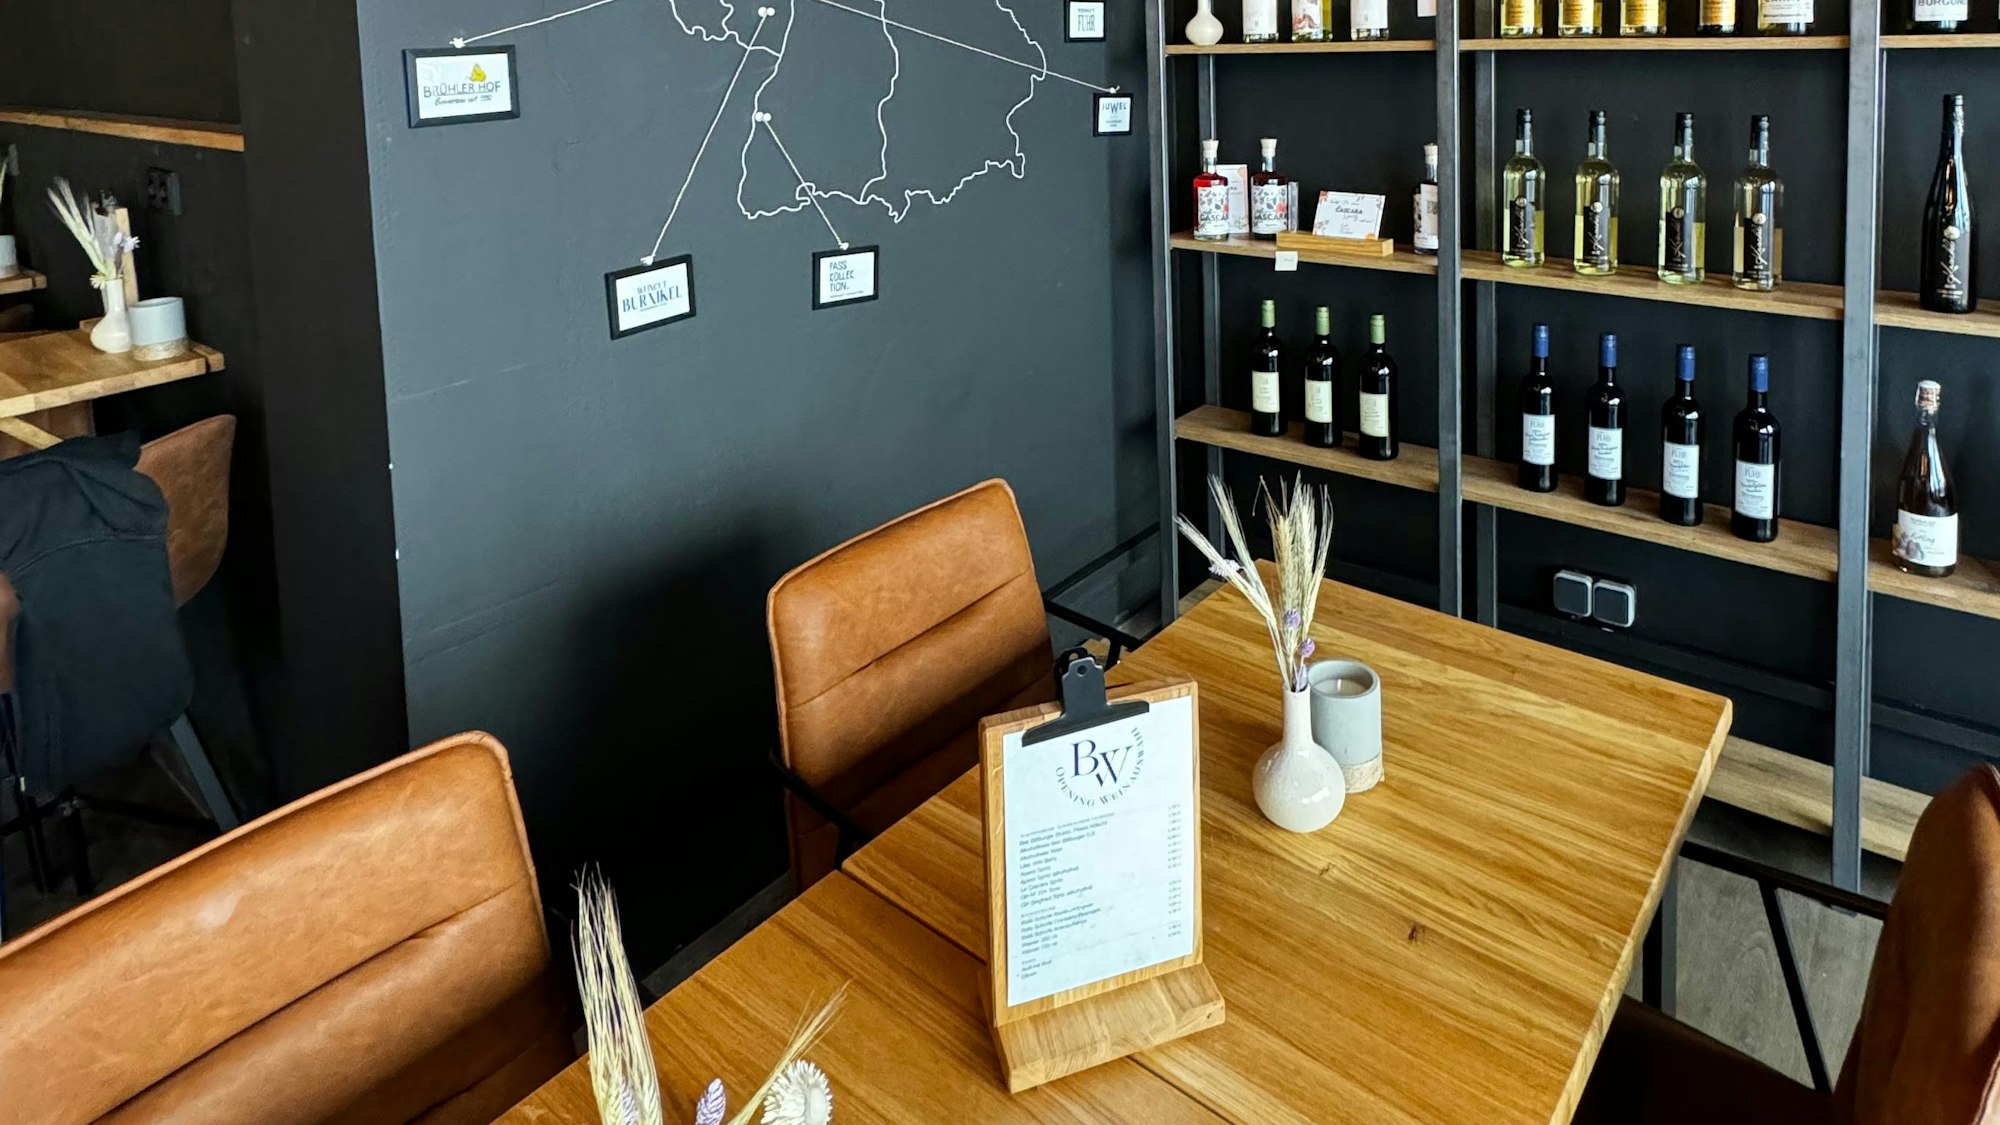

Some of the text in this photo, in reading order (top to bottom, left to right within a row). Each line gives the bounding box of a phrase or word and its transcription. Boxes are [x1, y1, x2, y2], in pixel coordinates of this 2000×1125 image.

[423, 80, 501, 98] BRÜHLER HOF
[1102, 102, 1127, 113] JUWEL
[1056, 766, 1095, 807] OPENING
